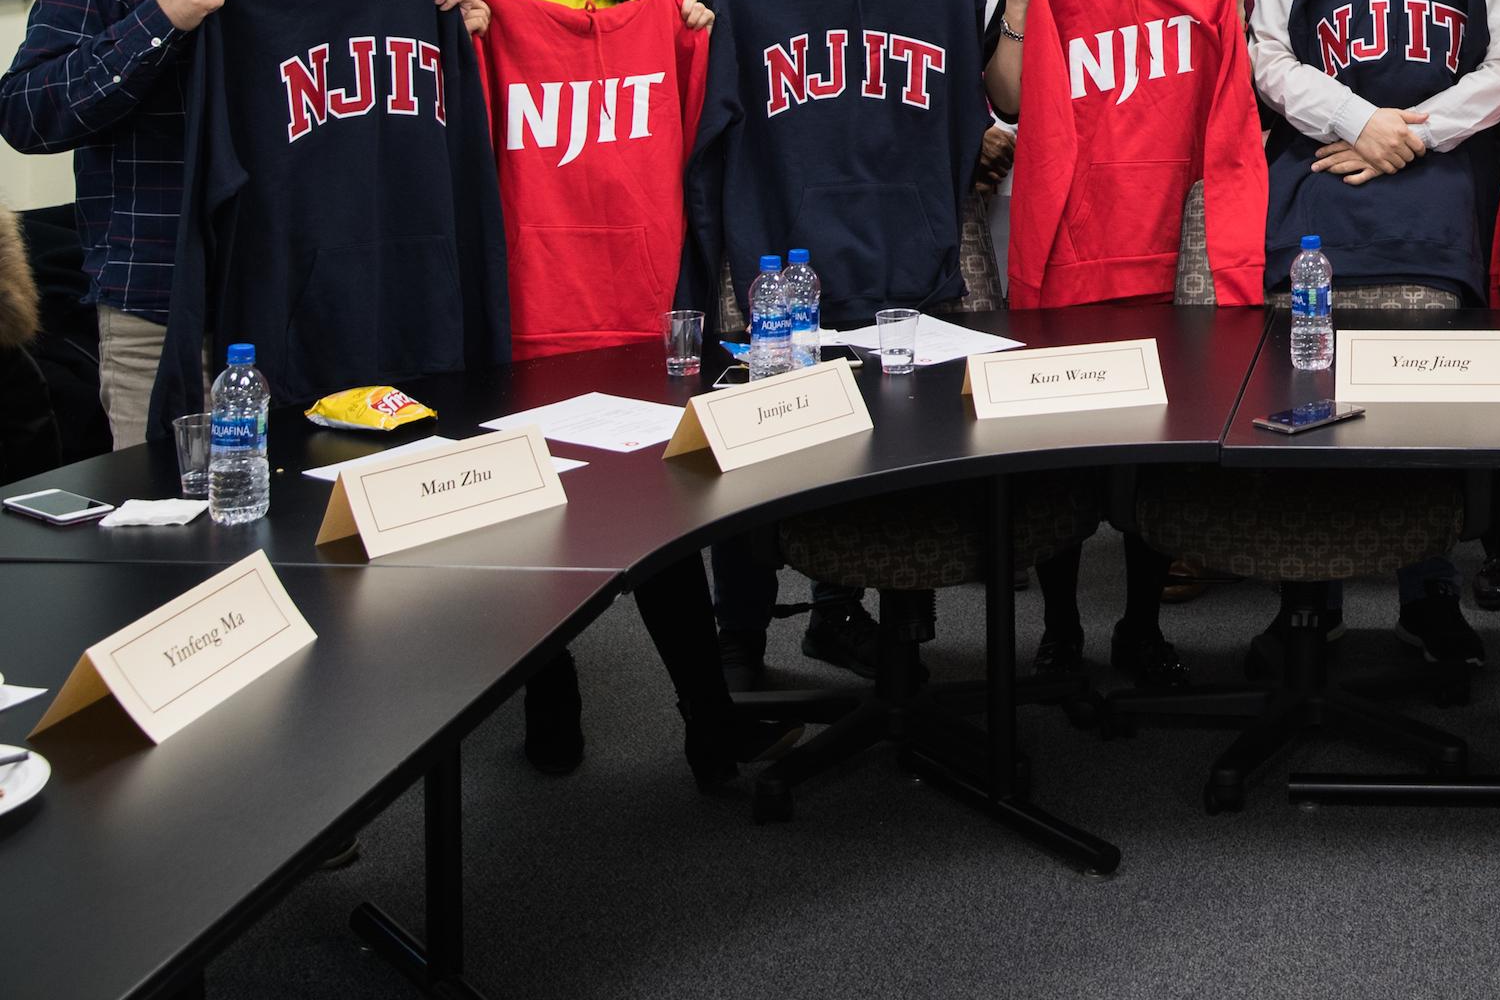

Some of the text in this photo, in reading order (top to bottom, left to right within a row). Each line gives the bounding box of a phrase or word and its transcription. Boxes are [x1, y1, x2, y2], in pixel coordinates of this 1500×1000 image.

[763, 28, 945, 118] NJIT
[1069, 14, 1203, 105] NJIT
[279, 36, 446, 143] NJIT
[506, 72, 665, 167] NJIT
[1029, 368, 1107, 386] Kun Wang
[1391, 354, 1471, 372] Yang Jiang
[211, 423, 254, 437] AQUAFINA
[756, 395, 810, 424] Junjie Li
[419, 468, 493, 497] Man Zhu
[162, 610, 246, 668] Yinfeng Ma
